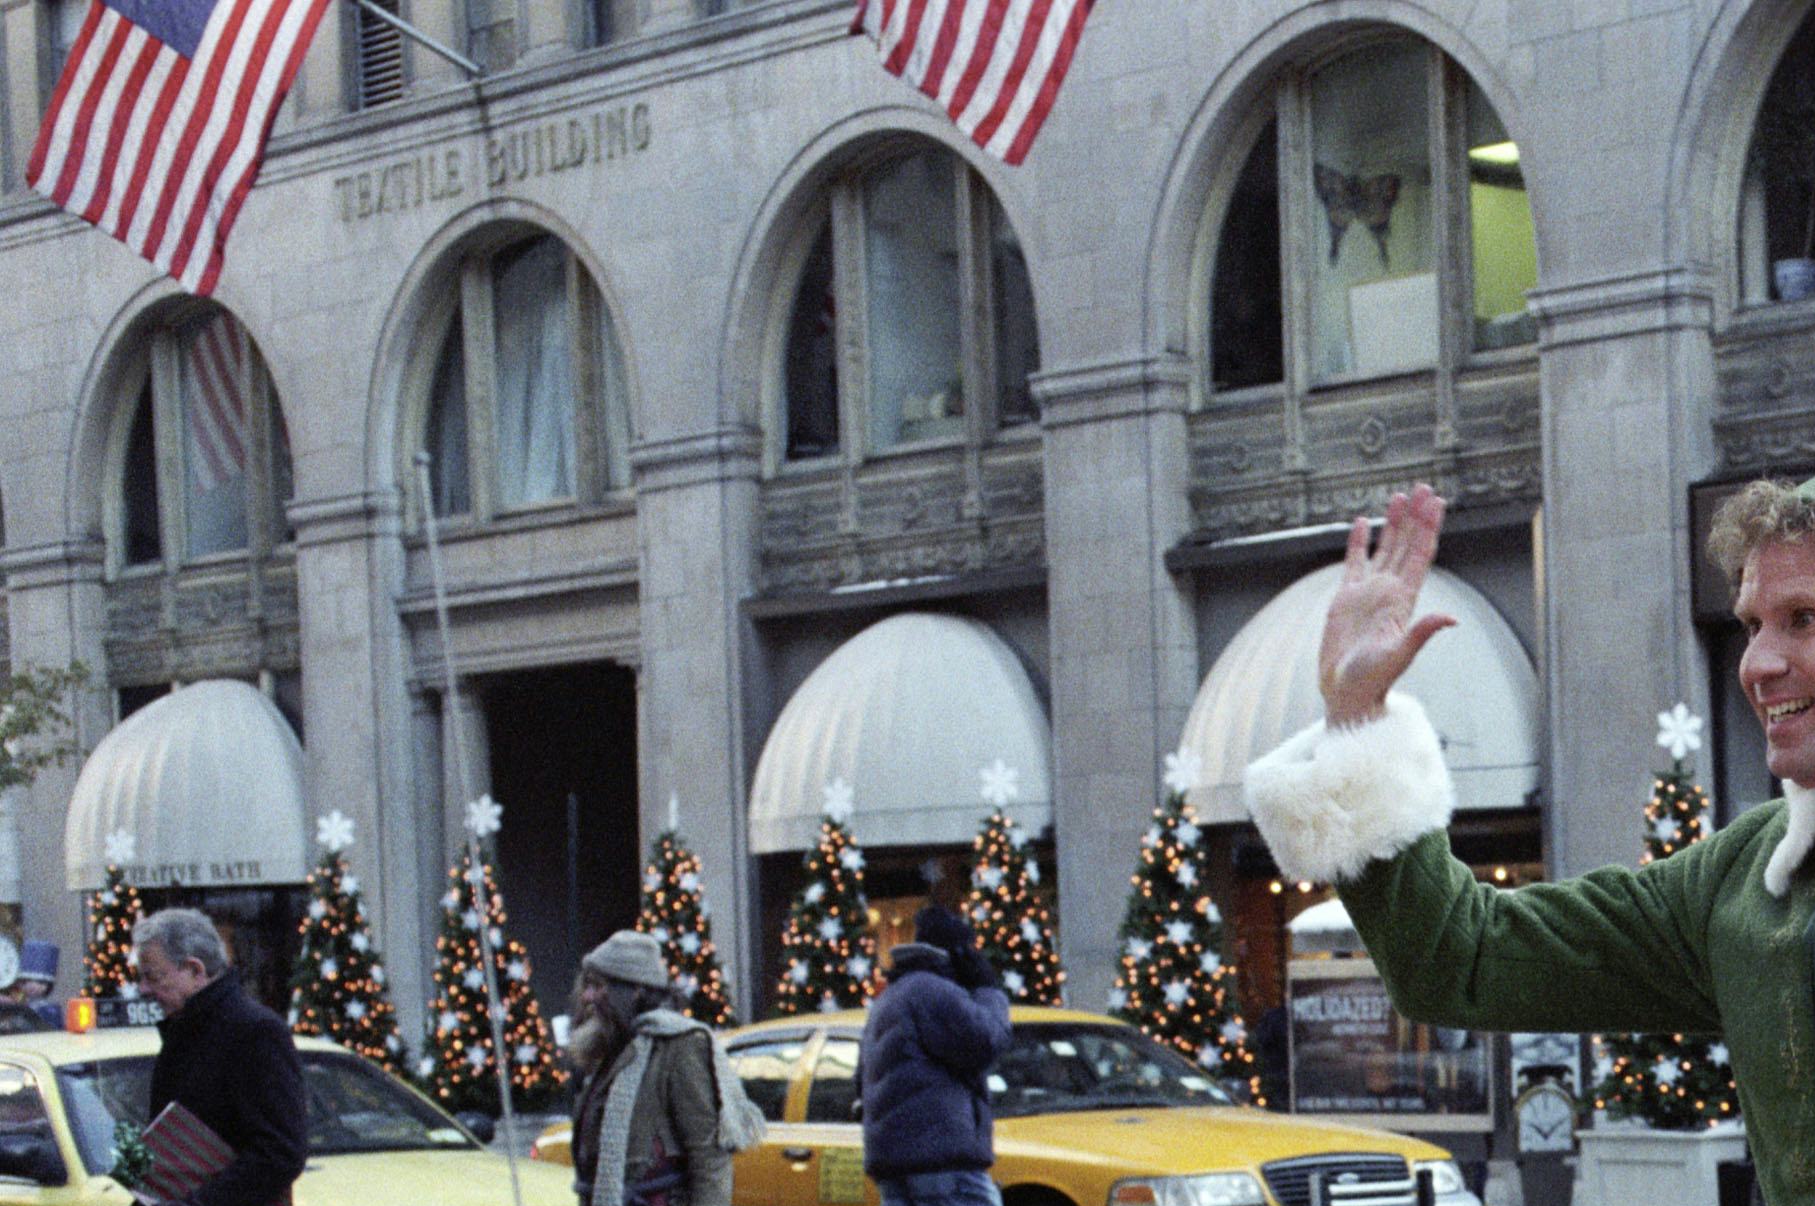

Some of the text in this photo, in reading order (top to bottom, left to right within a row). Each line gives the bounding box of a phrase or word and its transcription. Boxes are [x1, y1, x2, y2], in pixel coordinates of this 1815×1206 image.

[334, 102, 651, 222] TEXTILE BUILDING
[209, 860, 261, 881] BATH
